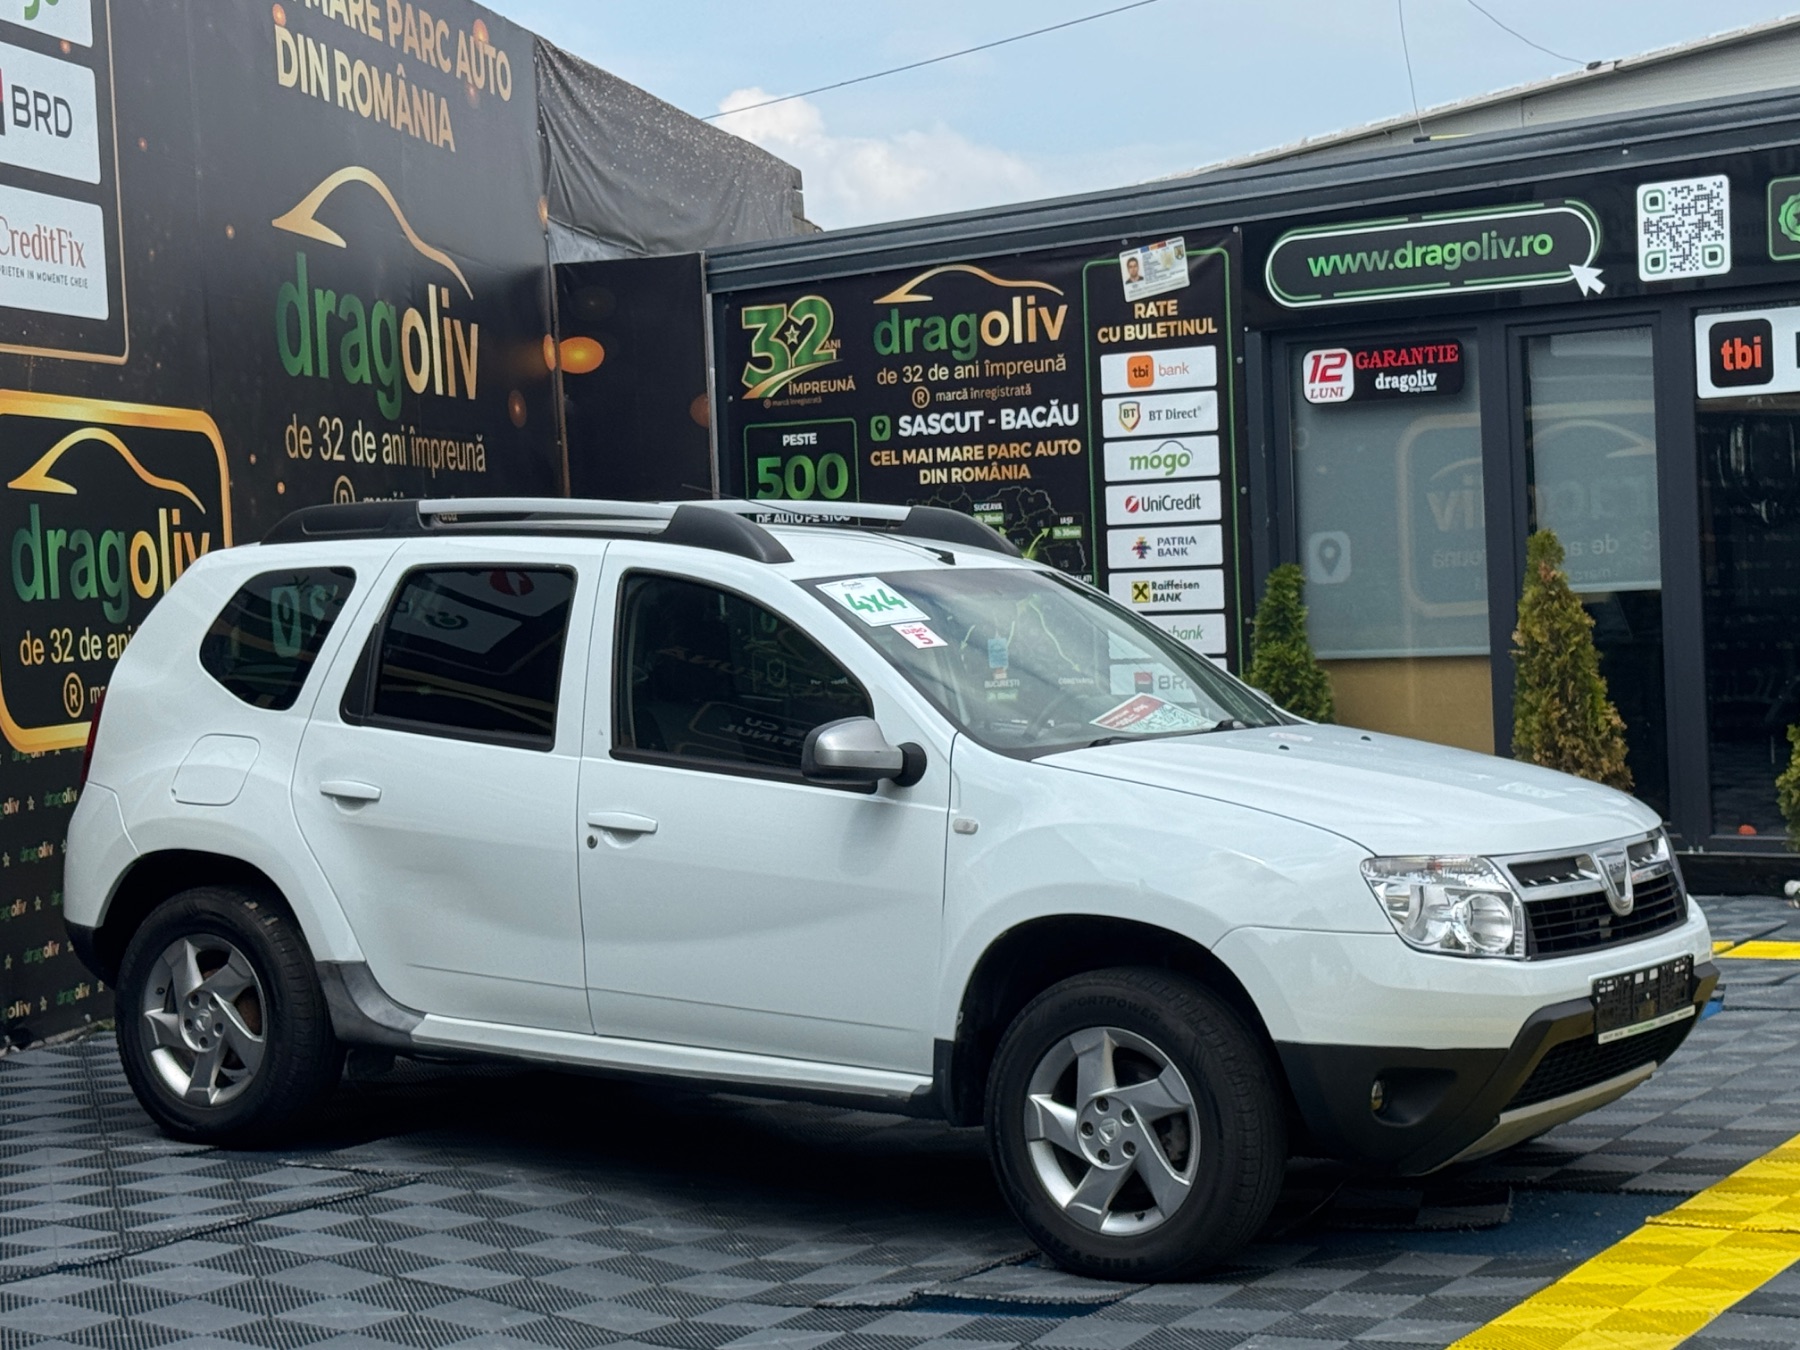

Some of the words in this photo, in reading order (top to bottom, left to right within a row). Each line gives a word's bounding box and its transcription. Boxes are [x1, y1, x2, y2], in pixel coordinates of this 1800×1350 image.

[387, 0, 451, 74] PARC
[456, 29, 512, 102] AUTO
[274, 24, 330, 102] DIN
[334, 49, 456, 152] ROMÂNIA
[11, 84, 73, 139] BRD
[1307, 230, 1554, 278] www.dragoliv.ro
[0, 264, 25, 279] RIETEN
[36, 272, 69, 286] MOMENTE
[1134, 299, 1179, 319] RATE
[276, 251, 479, 421] dragoliv
[873, 295, 1069, 361] dragoliv
[1097, 325, 1121, 343] CU
[1124, 317, 1218, 341] BULETINUL
[741, 295, 835, 389] 32
[823, 339, 842, 350] ANI
[1721, 336, 1763, 370] tbi
[1308, 352, 1348, 385] 12
[1355, 343, 1459, 370] GARANTIE
[876, 367, 898, 385] de
[902, 365, 924, 383] 32
[928, 363, 949, 381] de
[954, 360, 980, 379] ani
[984, 353, 1067, 380] împreună
[1132, 364, 1149, 379] tbi
[1158, 361, 1190, 377] bank
[1375, 368, 1437, 392] dragoliv
[788, 375, 857, 396] ÎMPREUNĂ
[935, 387, 969, 401] marcă
[970, 383, 1032, 400] înregistrată
[1310, 386, 1345, 399] LUNI
[898, 410, 985, 437] SASCUT
[1000, 399, 1079, 430] BACĂU
[1123, 407, 1136, 419] BT
[1148, 410, 1163, 421] BT
[285, 413, 312, 459] de
[318, 415, 346, 461] 32
[351, 419, 377, 463] de
[381, 424, 407, 466] ani
[409, 425, 486, 479] împreună
[782, 432, 818, 447] PESTE
[870, 450, 900, 466] CEL
[902, 448, 933, 464] MAI
[936, 445, 984, 463] MARE
[988, 442, 1031, 459] PARC
[1035, 438, 1081, 457] AUTO
[756, 452, 849, 500] 500
[919, 469, 948, 485] DIN
[951, 461, 1031, 483] ROMÂNIA
[1129, 453, 1191, 476] mogo
[973, 502, 1003, 512] SUCEAVA
[1141, 493, 1202, 512] UniCredit
[1157, 536, 1197, 546] PATRIA
[1157, 547, 1189, 557] BANK
[1151, 579, 1200, 591] Raiffeisen
[1152, 592, 1182, 603] BANK
[20, 630, 45, 666] de
[50, 627, 74, 664] 32
[79, 626, 102, 662] de
